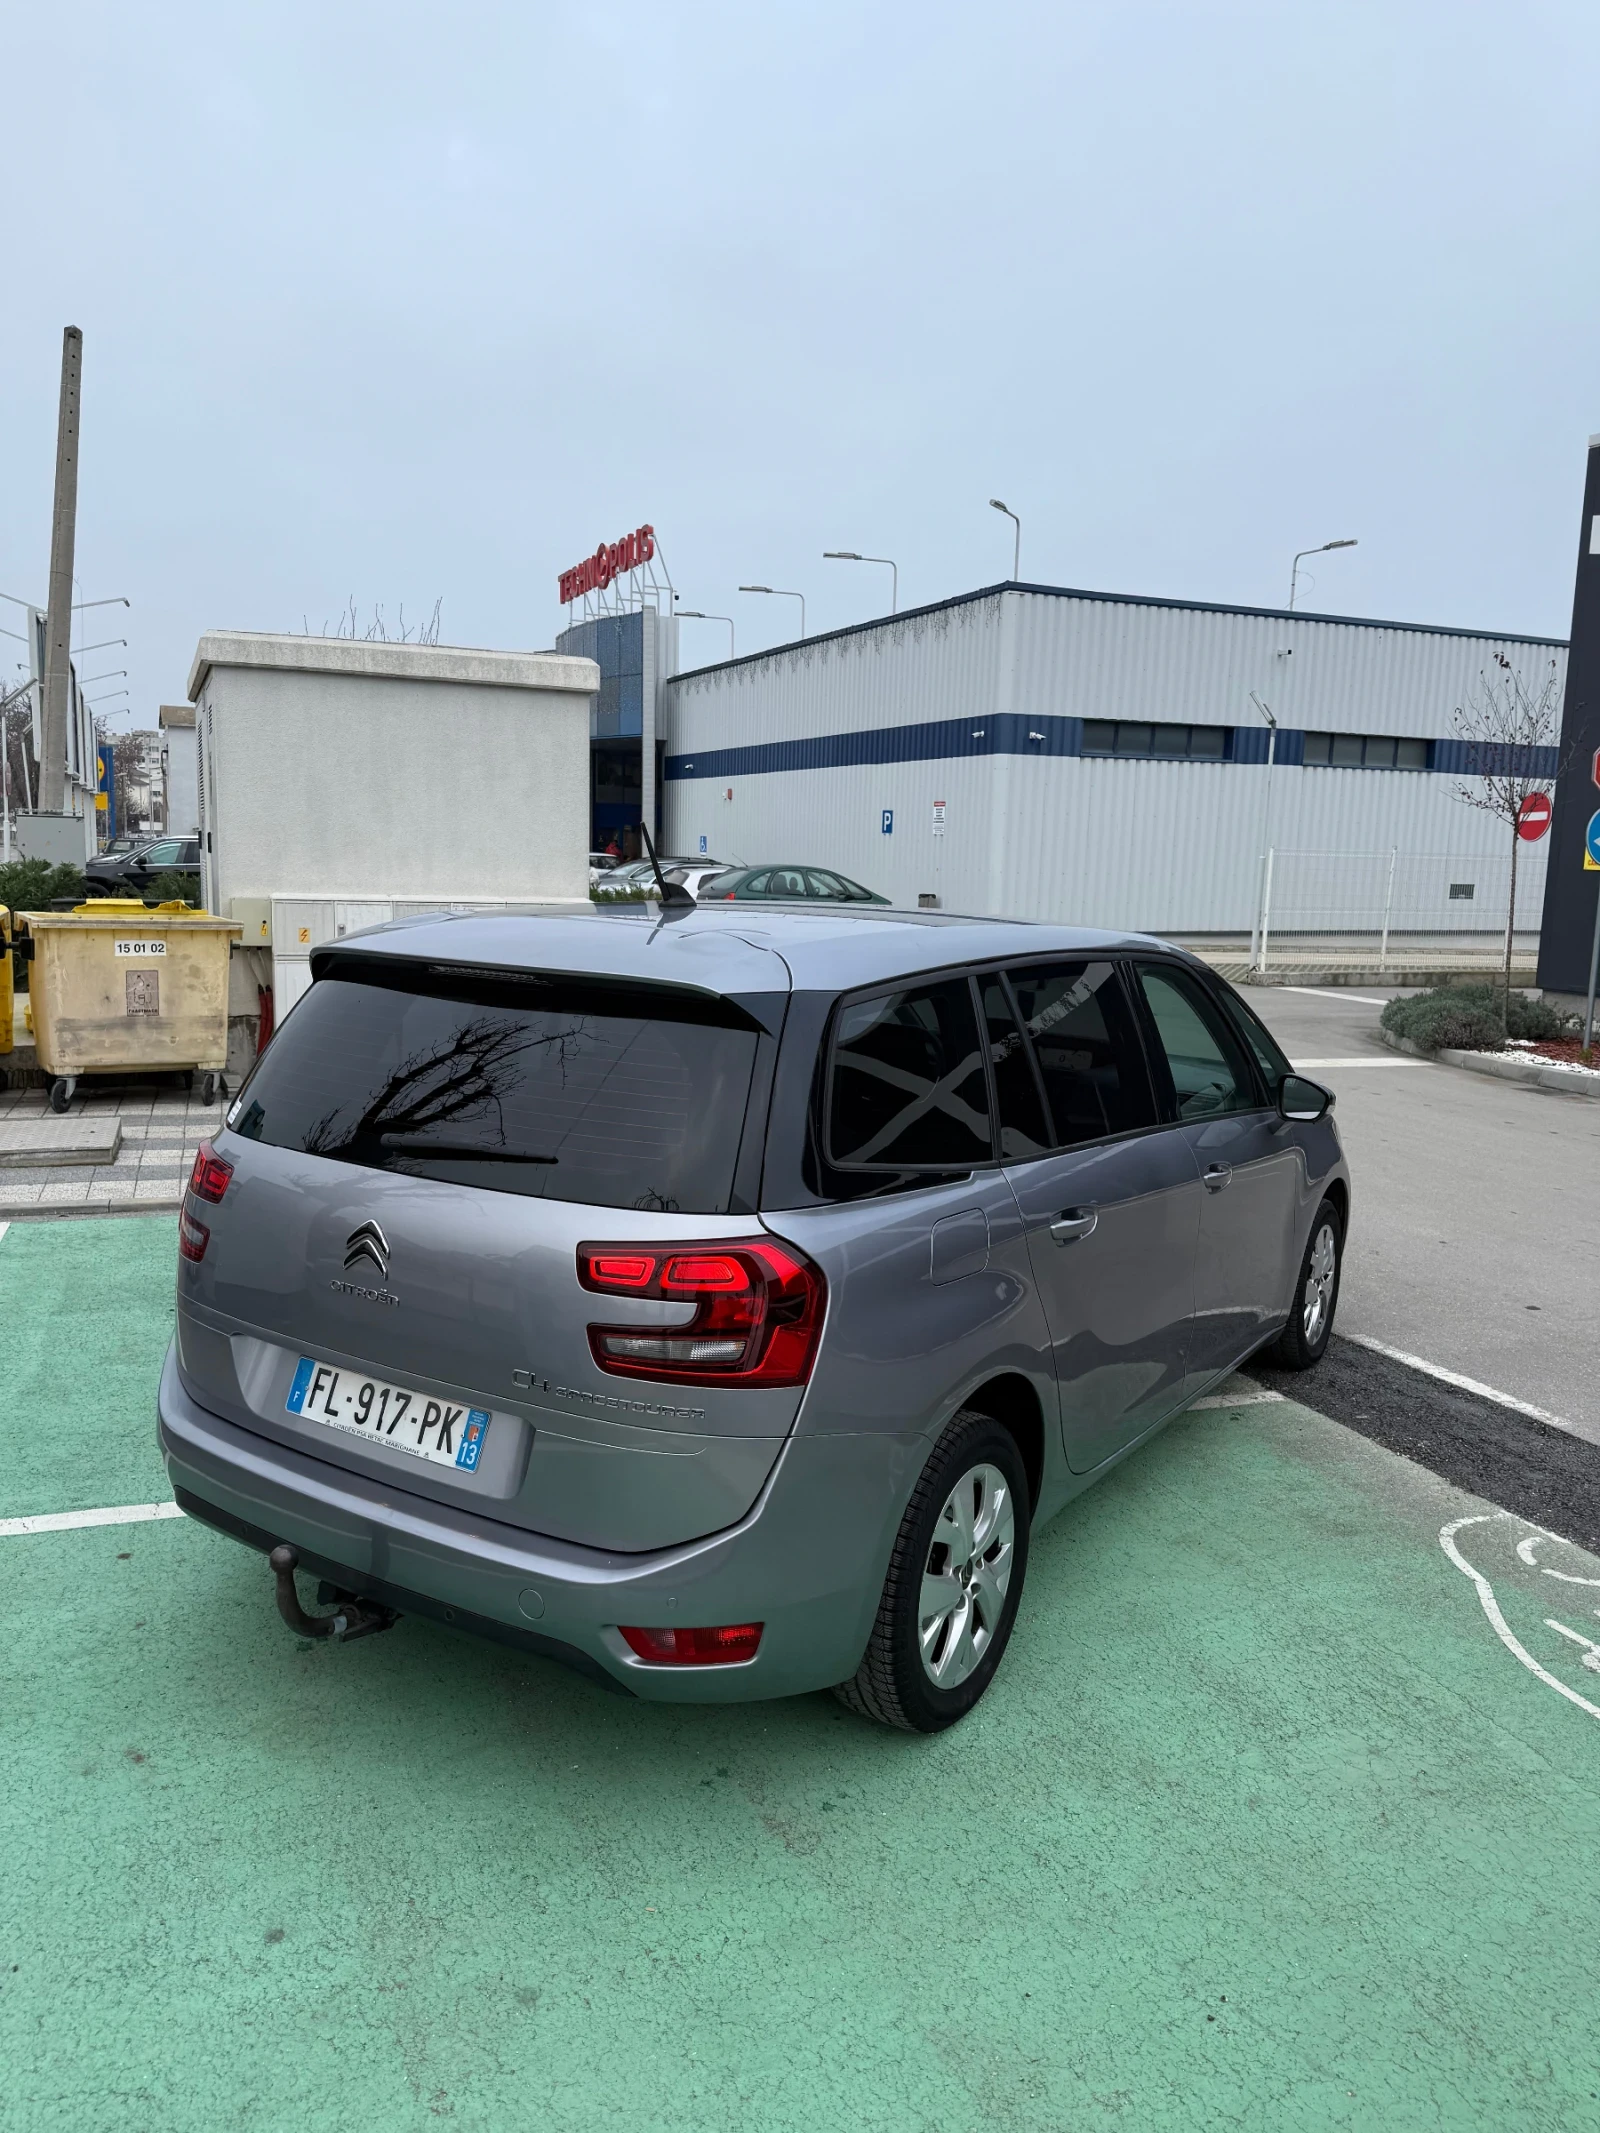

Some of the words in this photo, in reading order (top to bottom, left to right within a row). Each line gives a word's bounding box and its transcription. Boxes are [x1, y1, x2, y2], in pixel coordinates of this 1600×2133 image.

[558, 524, 654, 604] TECHNOPOLIS
[884, 812, 891, 831] P
[117, 944, 130, 953] 15
[134, 944, 146, 953] 01
[151, 944, 165, 953] 02
[330, 1280, 400, 1306] CITROËN
[293, 1391, 301, 1403] F
[511, 1368, 551, 1394] C4
[555, 1386, 706, 1419] SPACETOURER
[307, 1367, 463, 1455] FL-917-PK
[460, 1442, 478, 1465] 13
